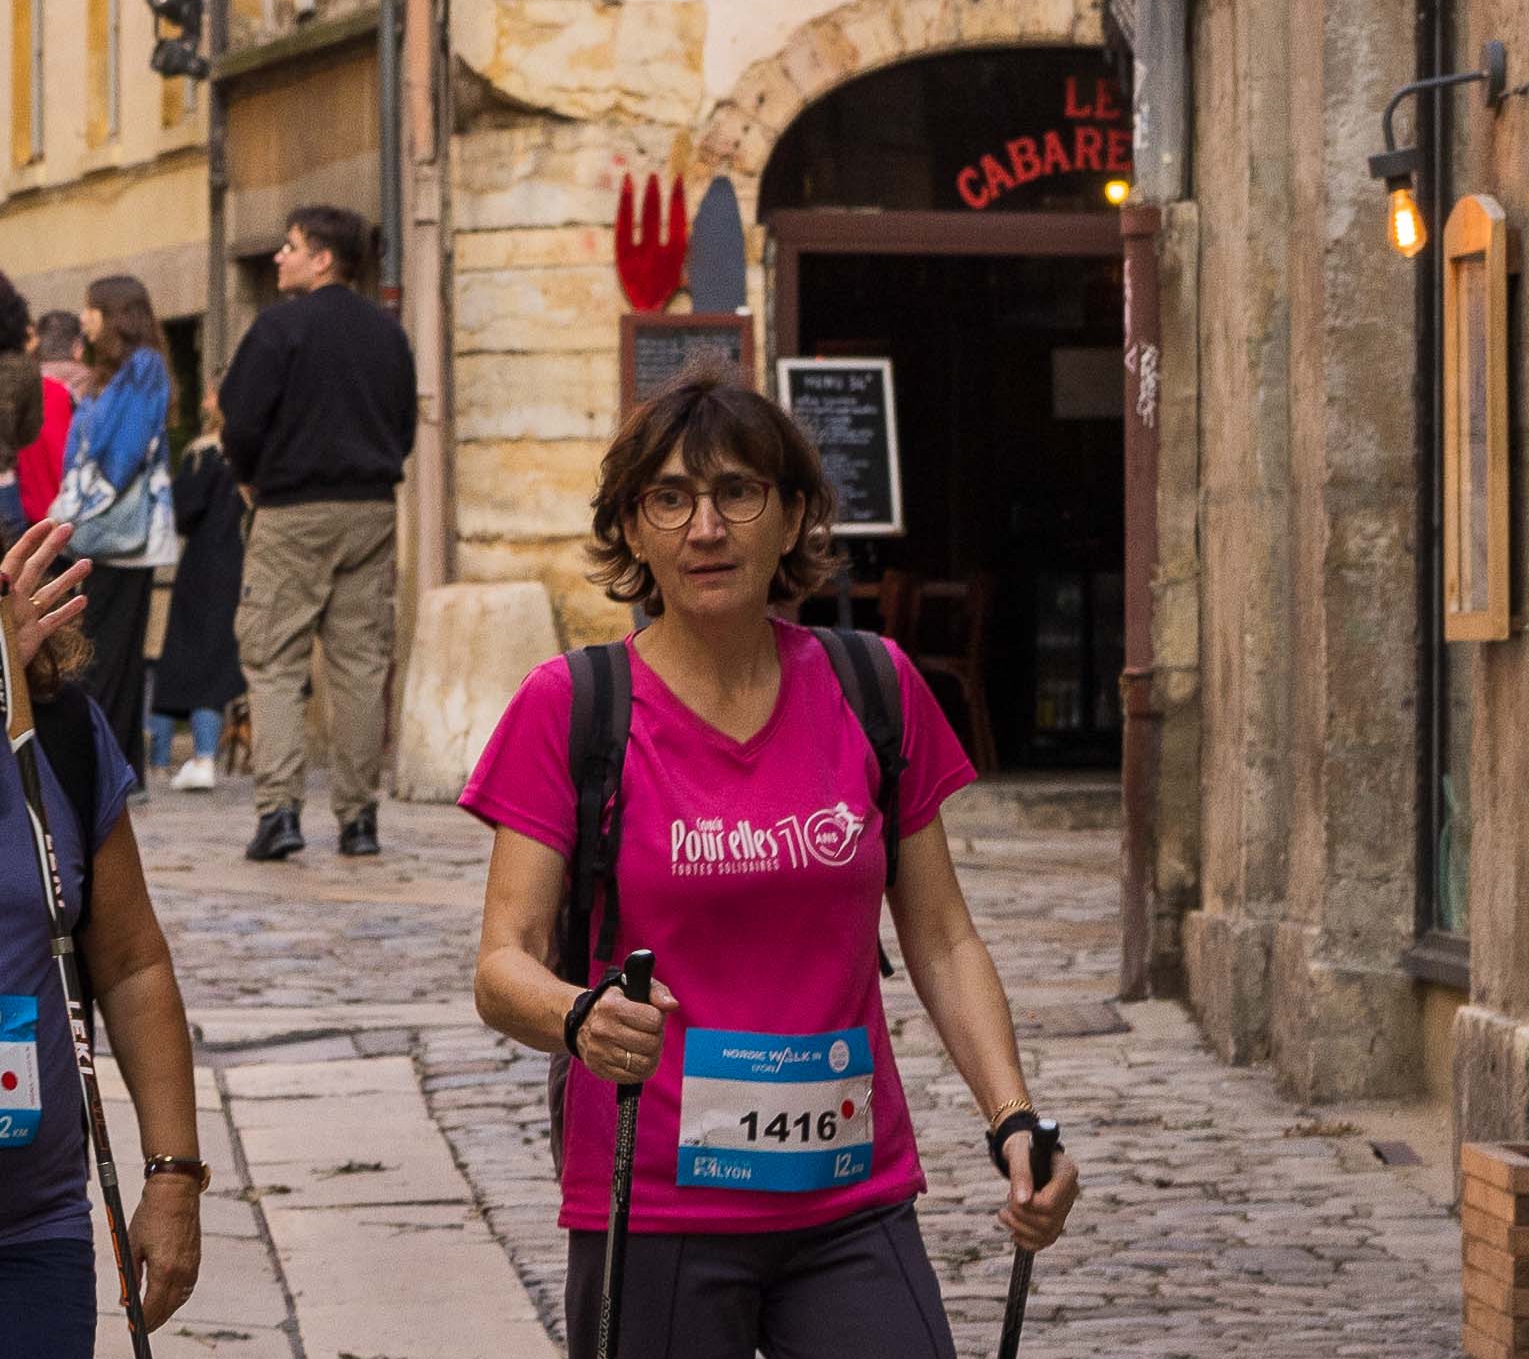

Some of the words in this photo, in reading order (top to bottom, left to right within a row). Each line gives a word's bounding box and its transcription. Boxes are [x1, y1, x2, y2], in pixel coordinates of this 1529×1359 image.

[1064, 75, 1121, 119] LE
[671, 818, 725, 863] Pour
[728, 820, 779, 860] elles
[671, 863, 714, 877] TOUTES
[739, 1110, 838, 1143] 1416
[834, 1152, 851, 1178] 12
